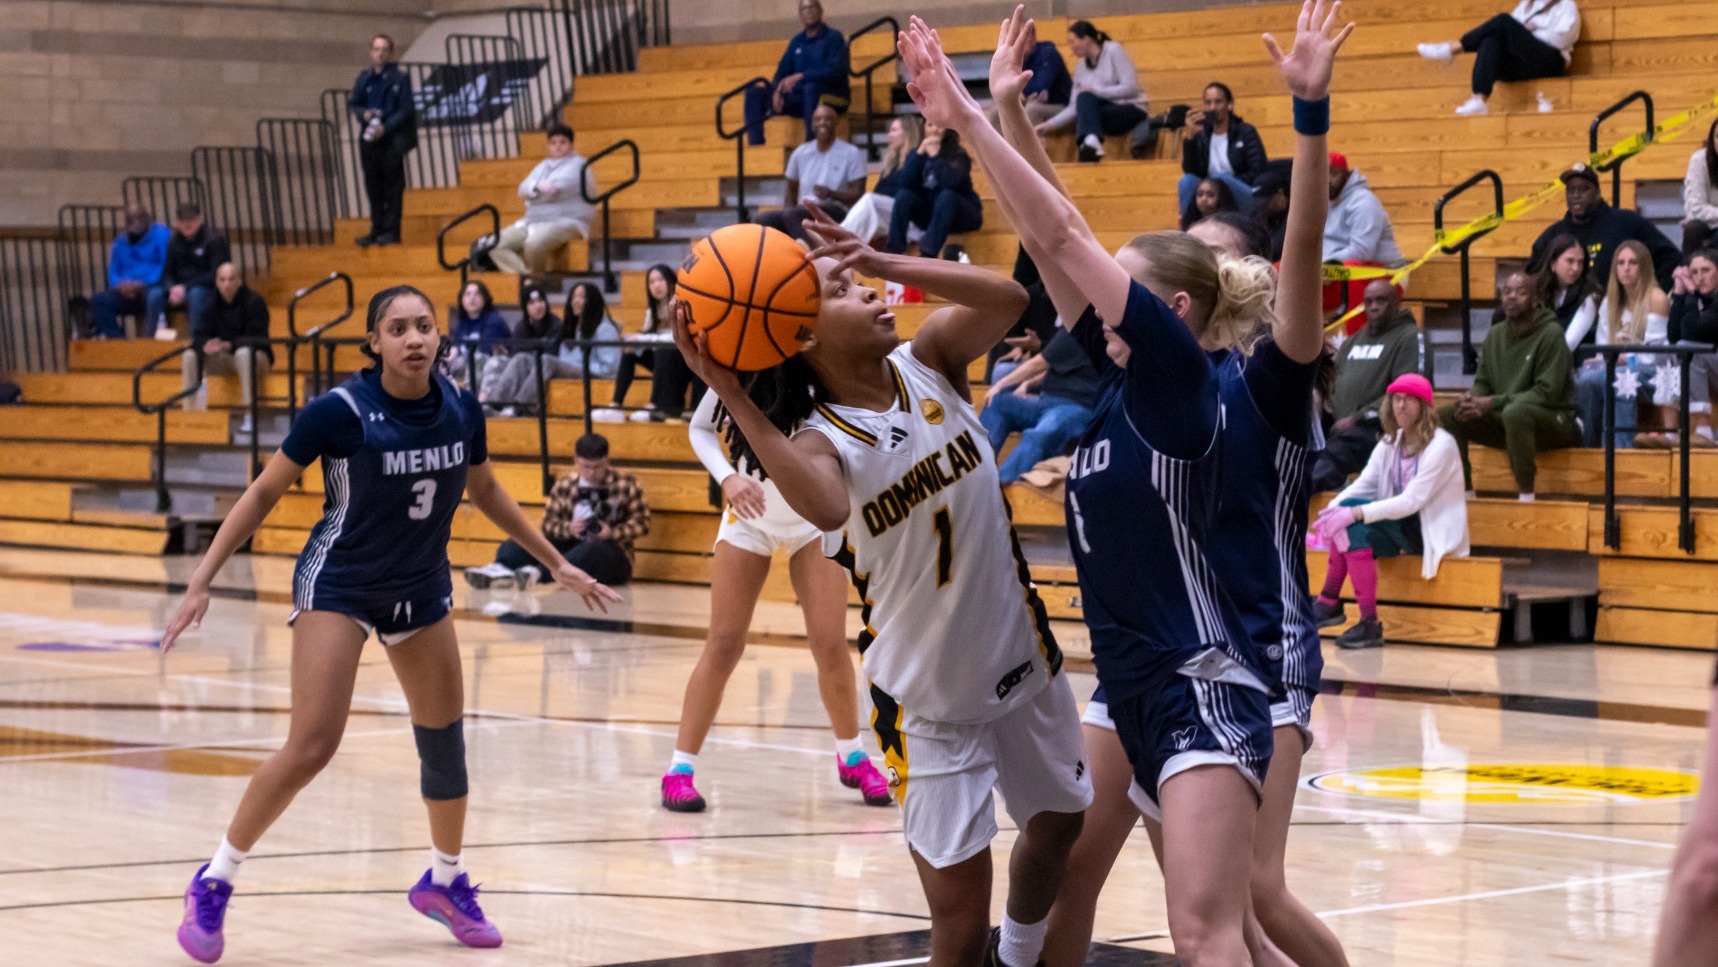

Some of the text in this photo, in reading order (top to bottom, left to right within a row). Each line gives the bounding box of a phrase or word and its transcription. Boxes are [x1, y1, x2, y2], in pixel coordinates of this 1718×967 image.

[382, 440, 464, 476] MENLO
[861, 430, 983, 538] DOMINICAN
[407, 478, 437, 520] 3
[932, 503, 955, 590] 1
